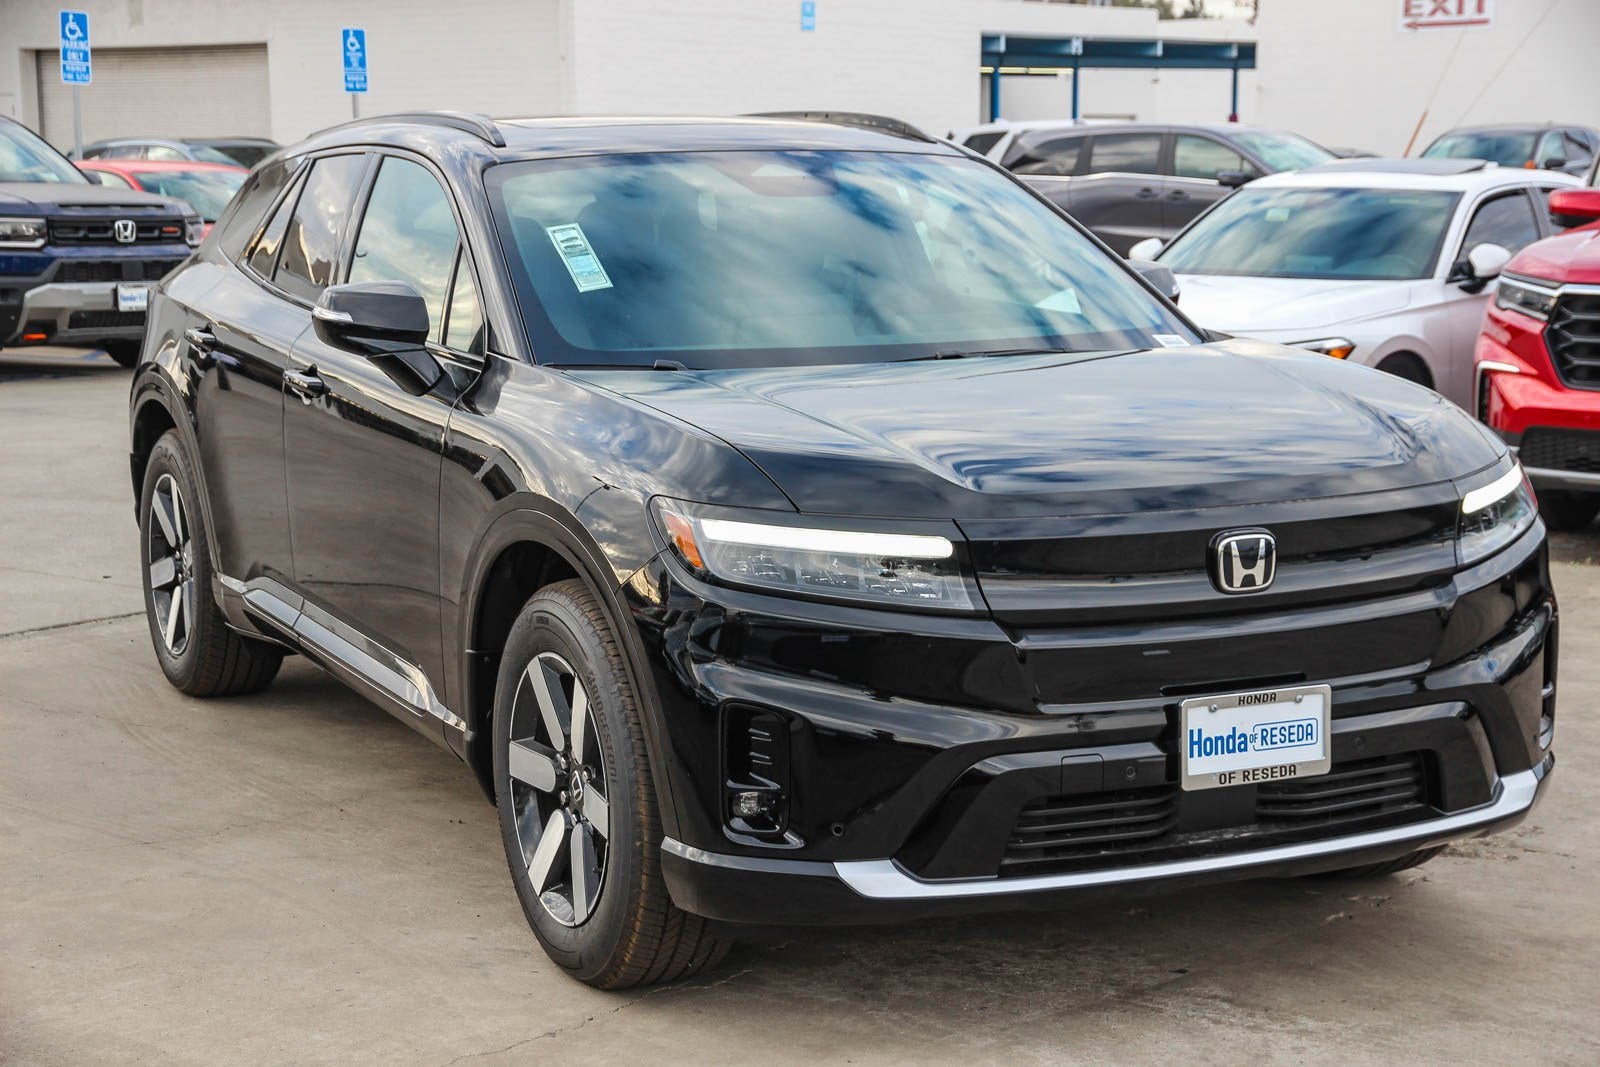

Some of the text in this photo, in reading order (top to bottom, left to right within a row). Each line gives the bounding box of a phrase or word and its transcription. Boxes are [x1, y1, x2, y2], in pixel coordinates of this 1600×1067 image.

[1238, 692, 1277, 706] HONDA
[1189, 723, 1314, 759] Honda OF RESEDA
[1218, 764, 1297, 785] OF RESEDA
